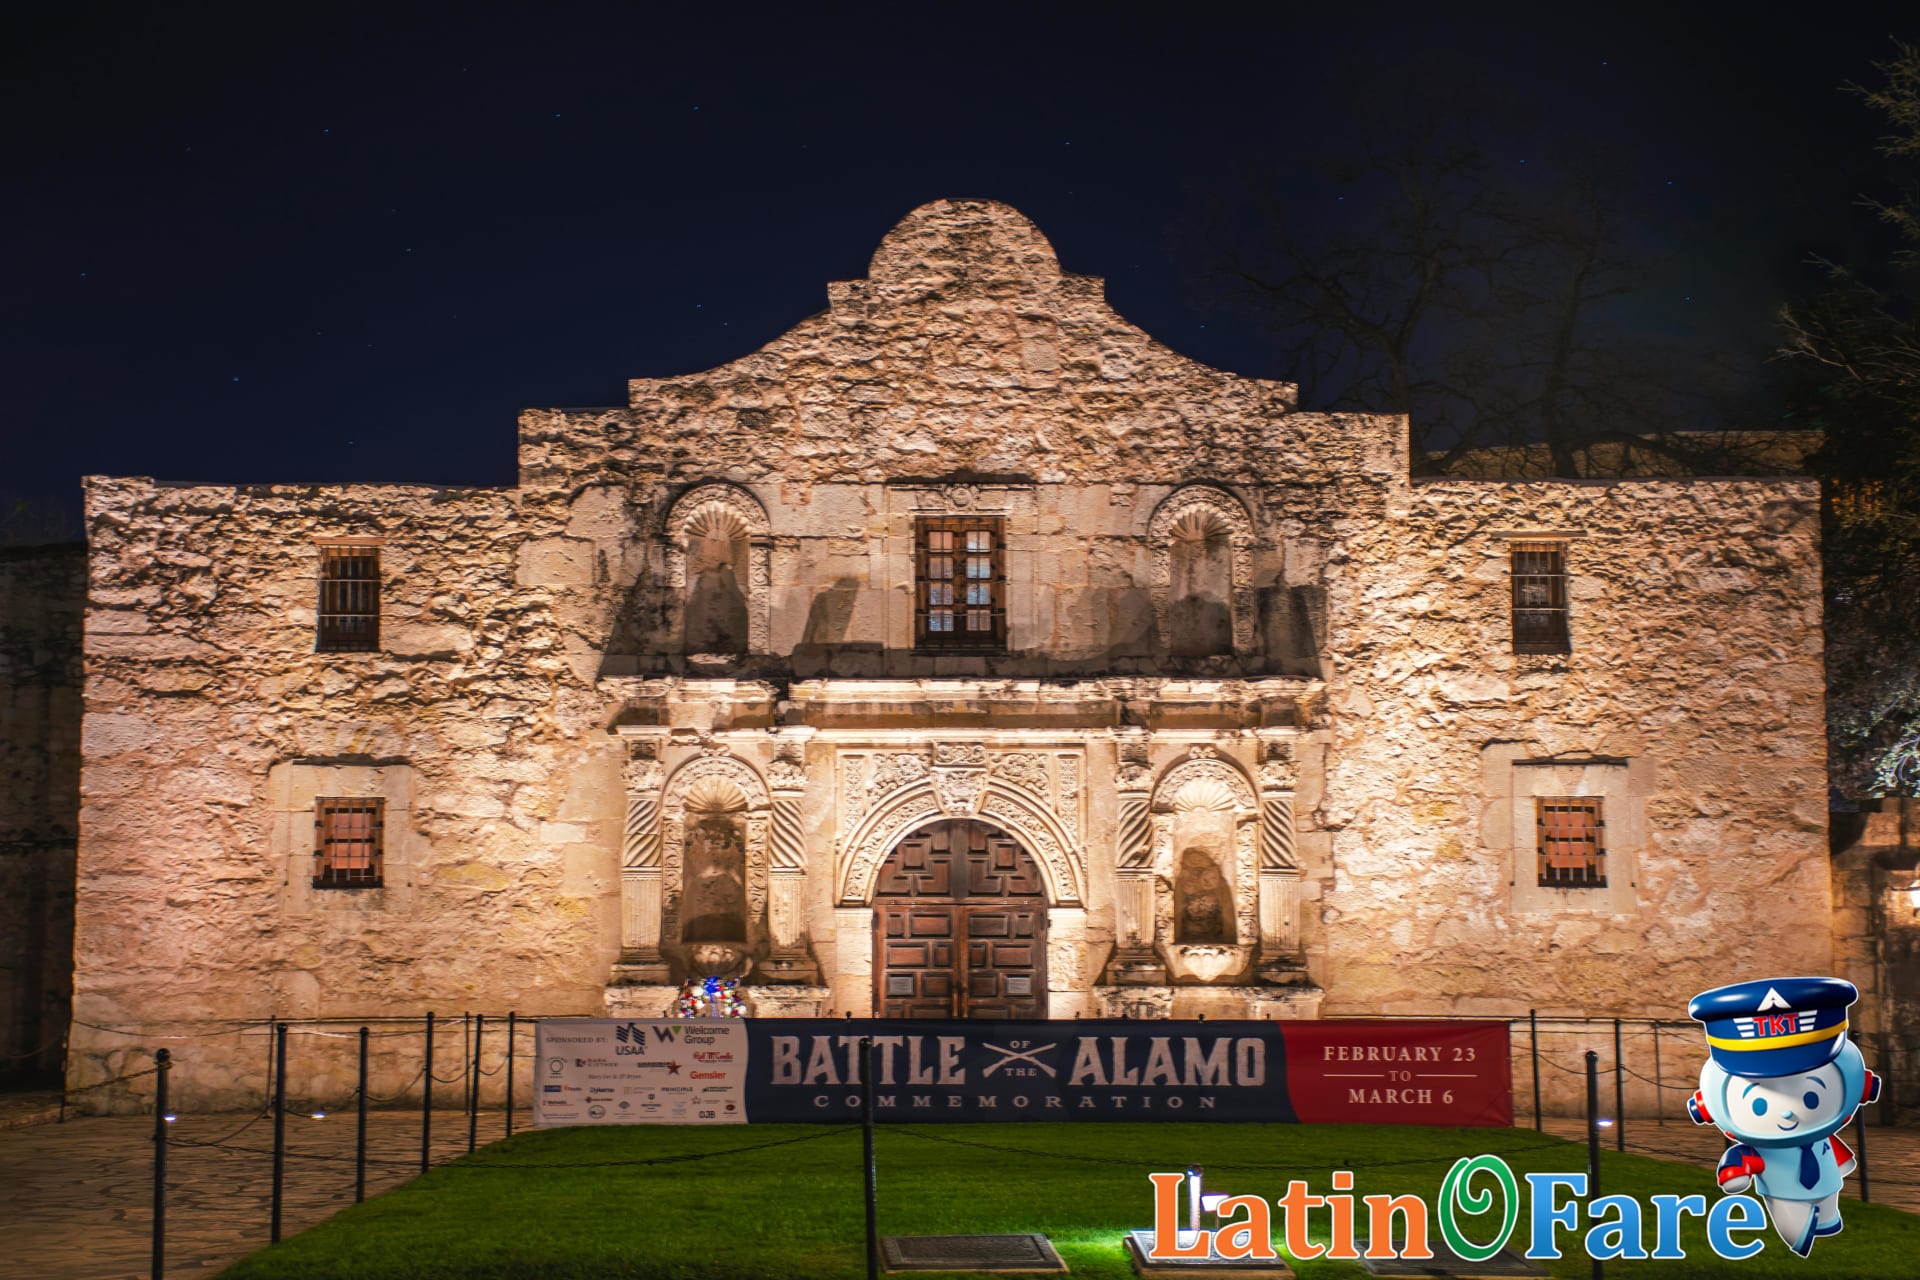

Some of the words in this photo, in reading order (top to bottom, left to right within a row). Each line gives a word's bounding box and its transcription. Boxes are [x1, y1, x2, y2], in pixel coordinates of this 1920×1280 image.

[684, 1026, 730, 1035] Welcome
[684, 1035, 715, 1045] Group
[1009, 1040, 1031, 1049] OF
[616, 1046, 645, 1055] USAA
[1323, 1046, 1442, 1061] FEBRUARY
[1453, 1047, 1476, 1062] 23
[770, 1035, 966, 1085] BATTLE
[1068, 1036, 1266, 1087] ALAMO
[690, 1071, 727, 1079] Gensler
[1005, 1067, 1037, 1077] THE
[1387, 1070, 1412, 1082] TO
[814, 1095, 1217, 1108] COMMEMORATION
[1348, 1089, 1432, 1104] MARCH
[1442, 1090, 1454, 1104] 6
